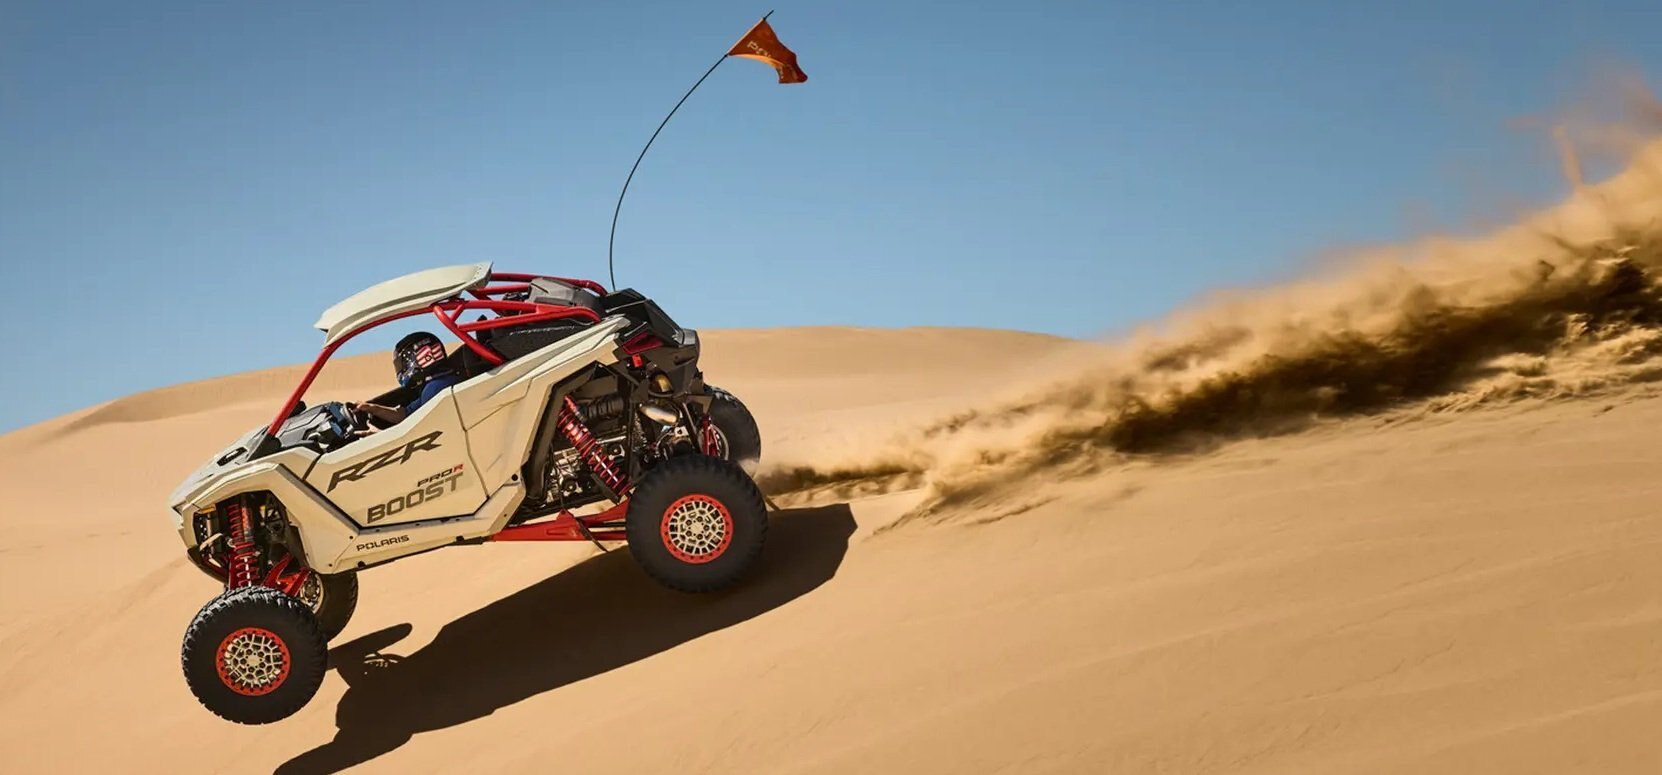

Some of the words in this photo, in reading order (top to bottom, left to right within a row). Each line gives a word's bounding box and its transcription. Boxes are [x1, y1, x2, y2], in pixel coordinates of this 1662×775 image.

[327, 431, 443, 494] RZR
[367, 471, 464, 524] BOOST
[356, 534, 410, 551] POLARIS
